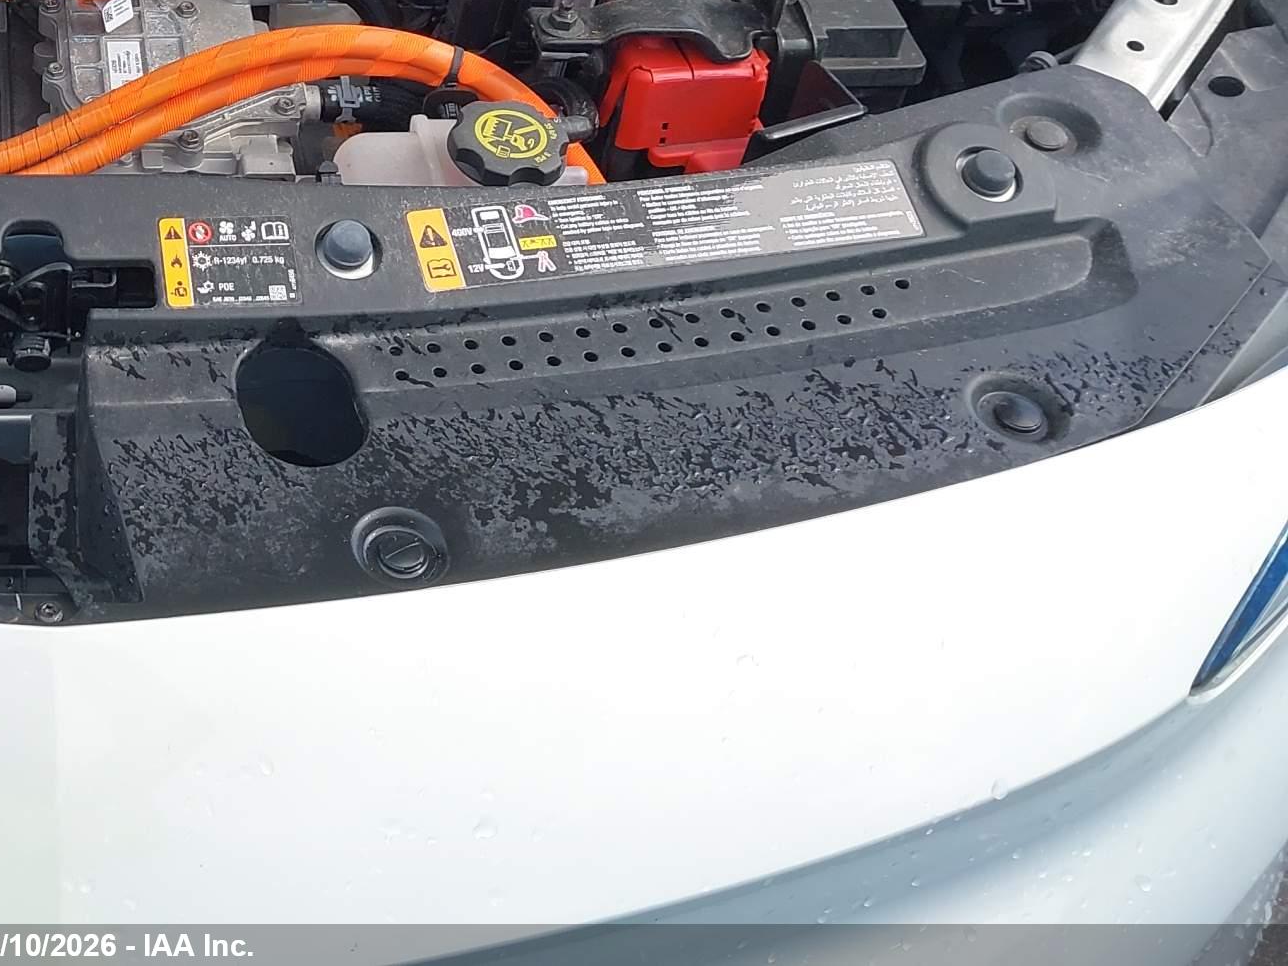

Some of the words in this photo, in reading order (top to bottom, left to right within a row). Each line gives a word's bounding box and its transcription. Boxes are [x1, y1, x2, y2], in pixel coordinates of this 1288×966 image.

[451, 227, 474, 237] 400V
[252, 256, 274, 264] 0.725
[467, 264, 485, 273] 12V
[218, 282, 235, 291] POE
